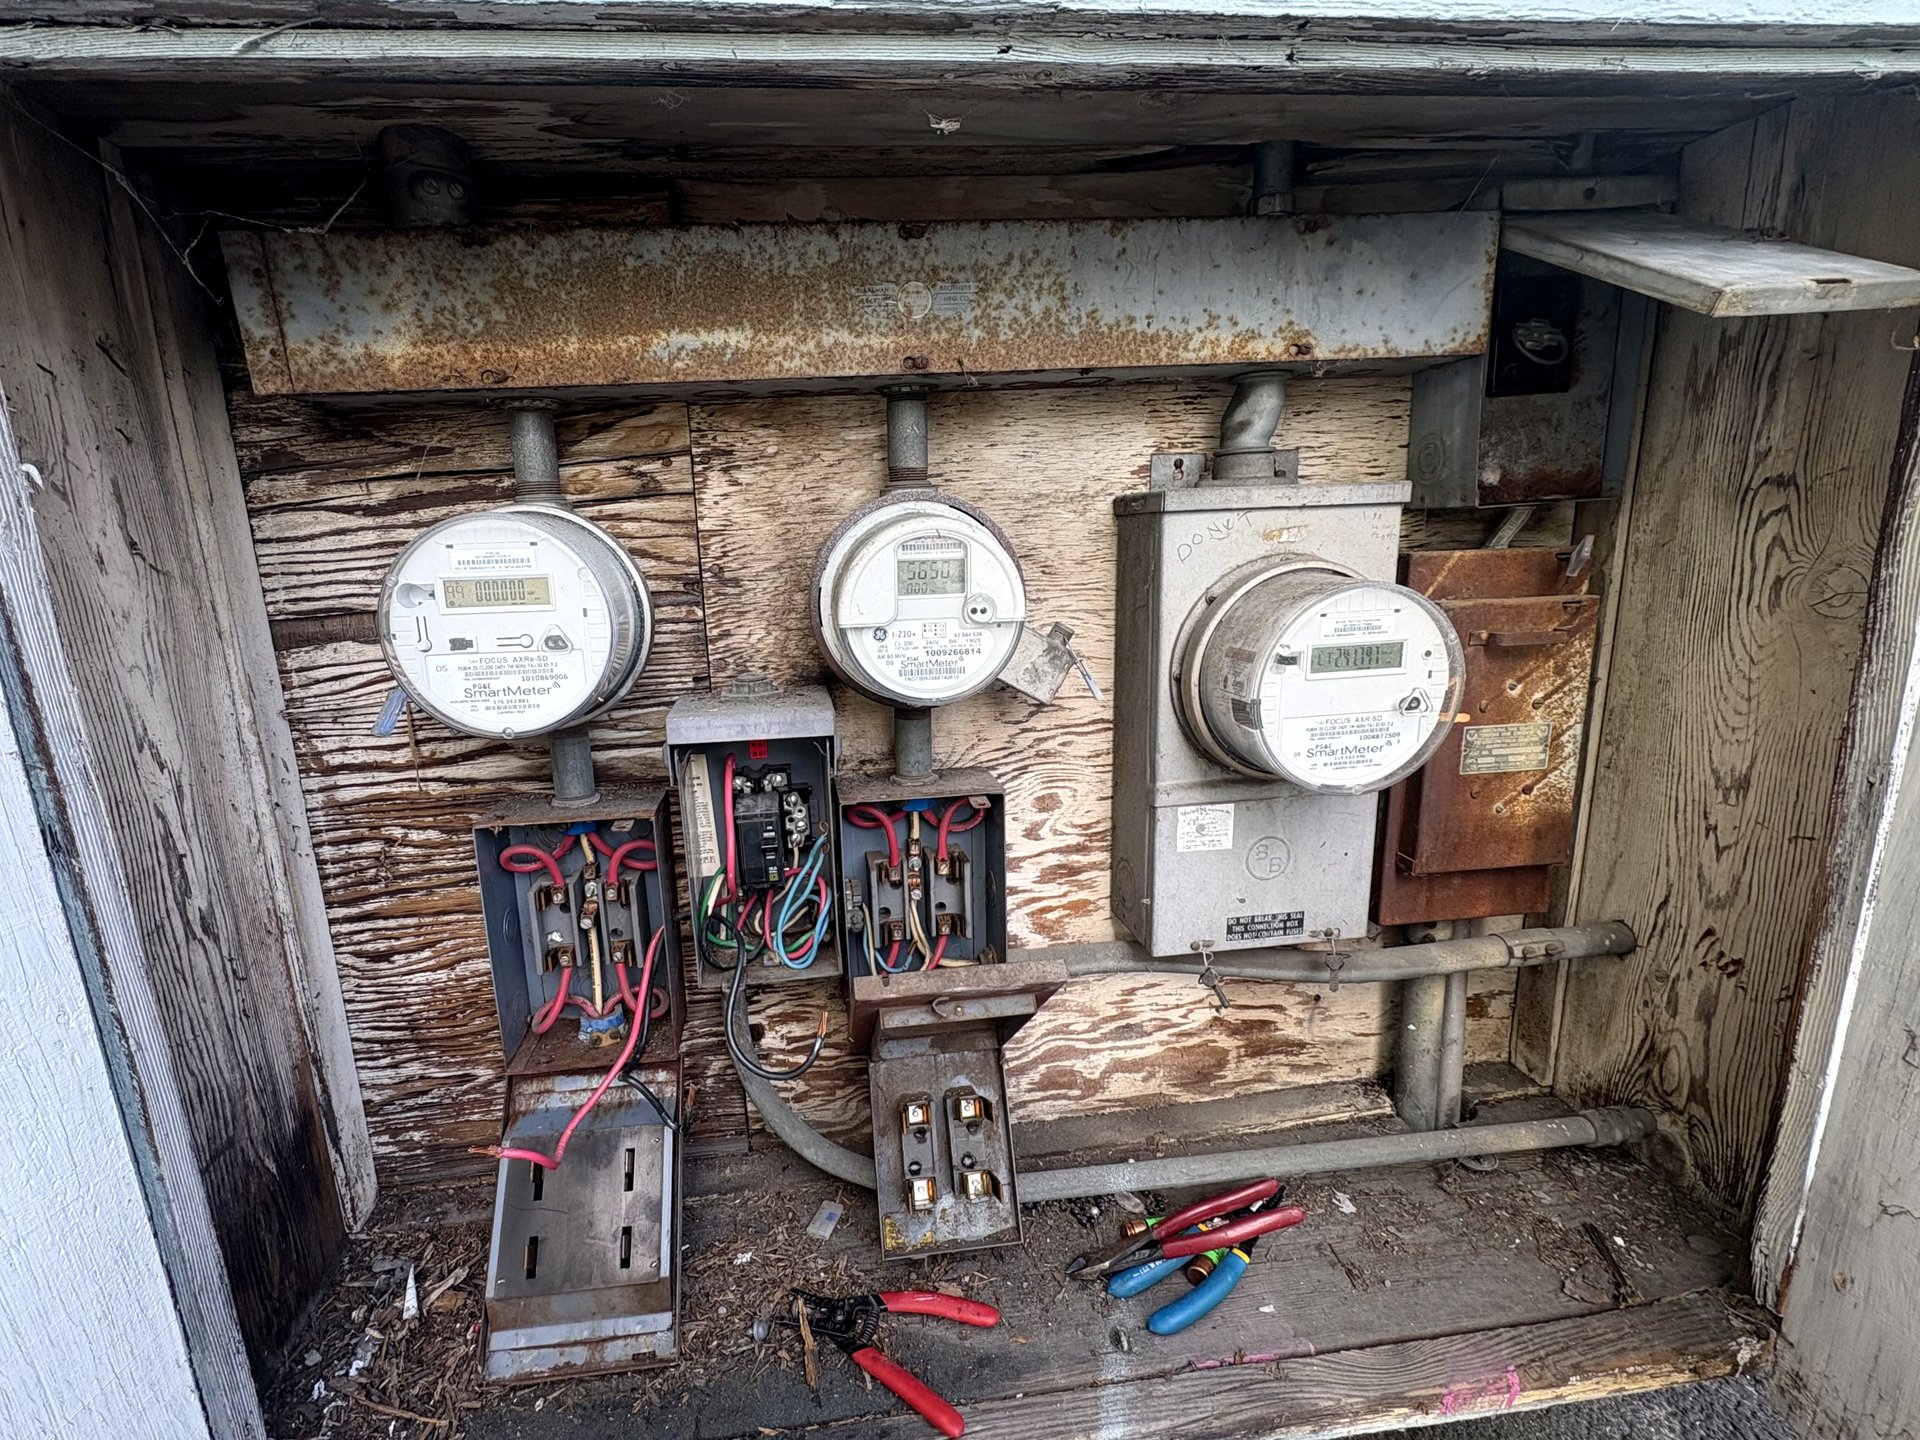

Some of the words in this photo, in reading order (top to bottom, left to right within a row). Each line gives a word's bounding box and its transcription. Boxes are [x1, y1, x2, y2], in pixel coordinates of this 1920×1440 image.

[925, 648, 982, 657] 1009266814
[479, 656, 508, 664] FOCUS
[512, 655, 549, 663] AXRe-SD
[900, 659, 959, 669] SmartMeter
[521, 674, 569, 682] 1010869006
[463, 685, 552, 699] SmartMeter
[1325, 717, 1351, 725] FOCUS
[1354, 715, 1383, 723] AXR-SD
[1306, 744, 1385, 758] SmartMeter
[1240, 916, 1252, 924] NOT
[1254, 915, 1272, 923] BREAK
[1290, 912, 1303, 920] SEAL
[1232, 924, 1245, 932] THIS
[1247, 921, 1284, 931] CONNECTION
[1243, 931, 1257, 939] NOT
[1257, 929, 1284, 938] CONTAIN
[1286, 927, 1303, 935] FUSES
